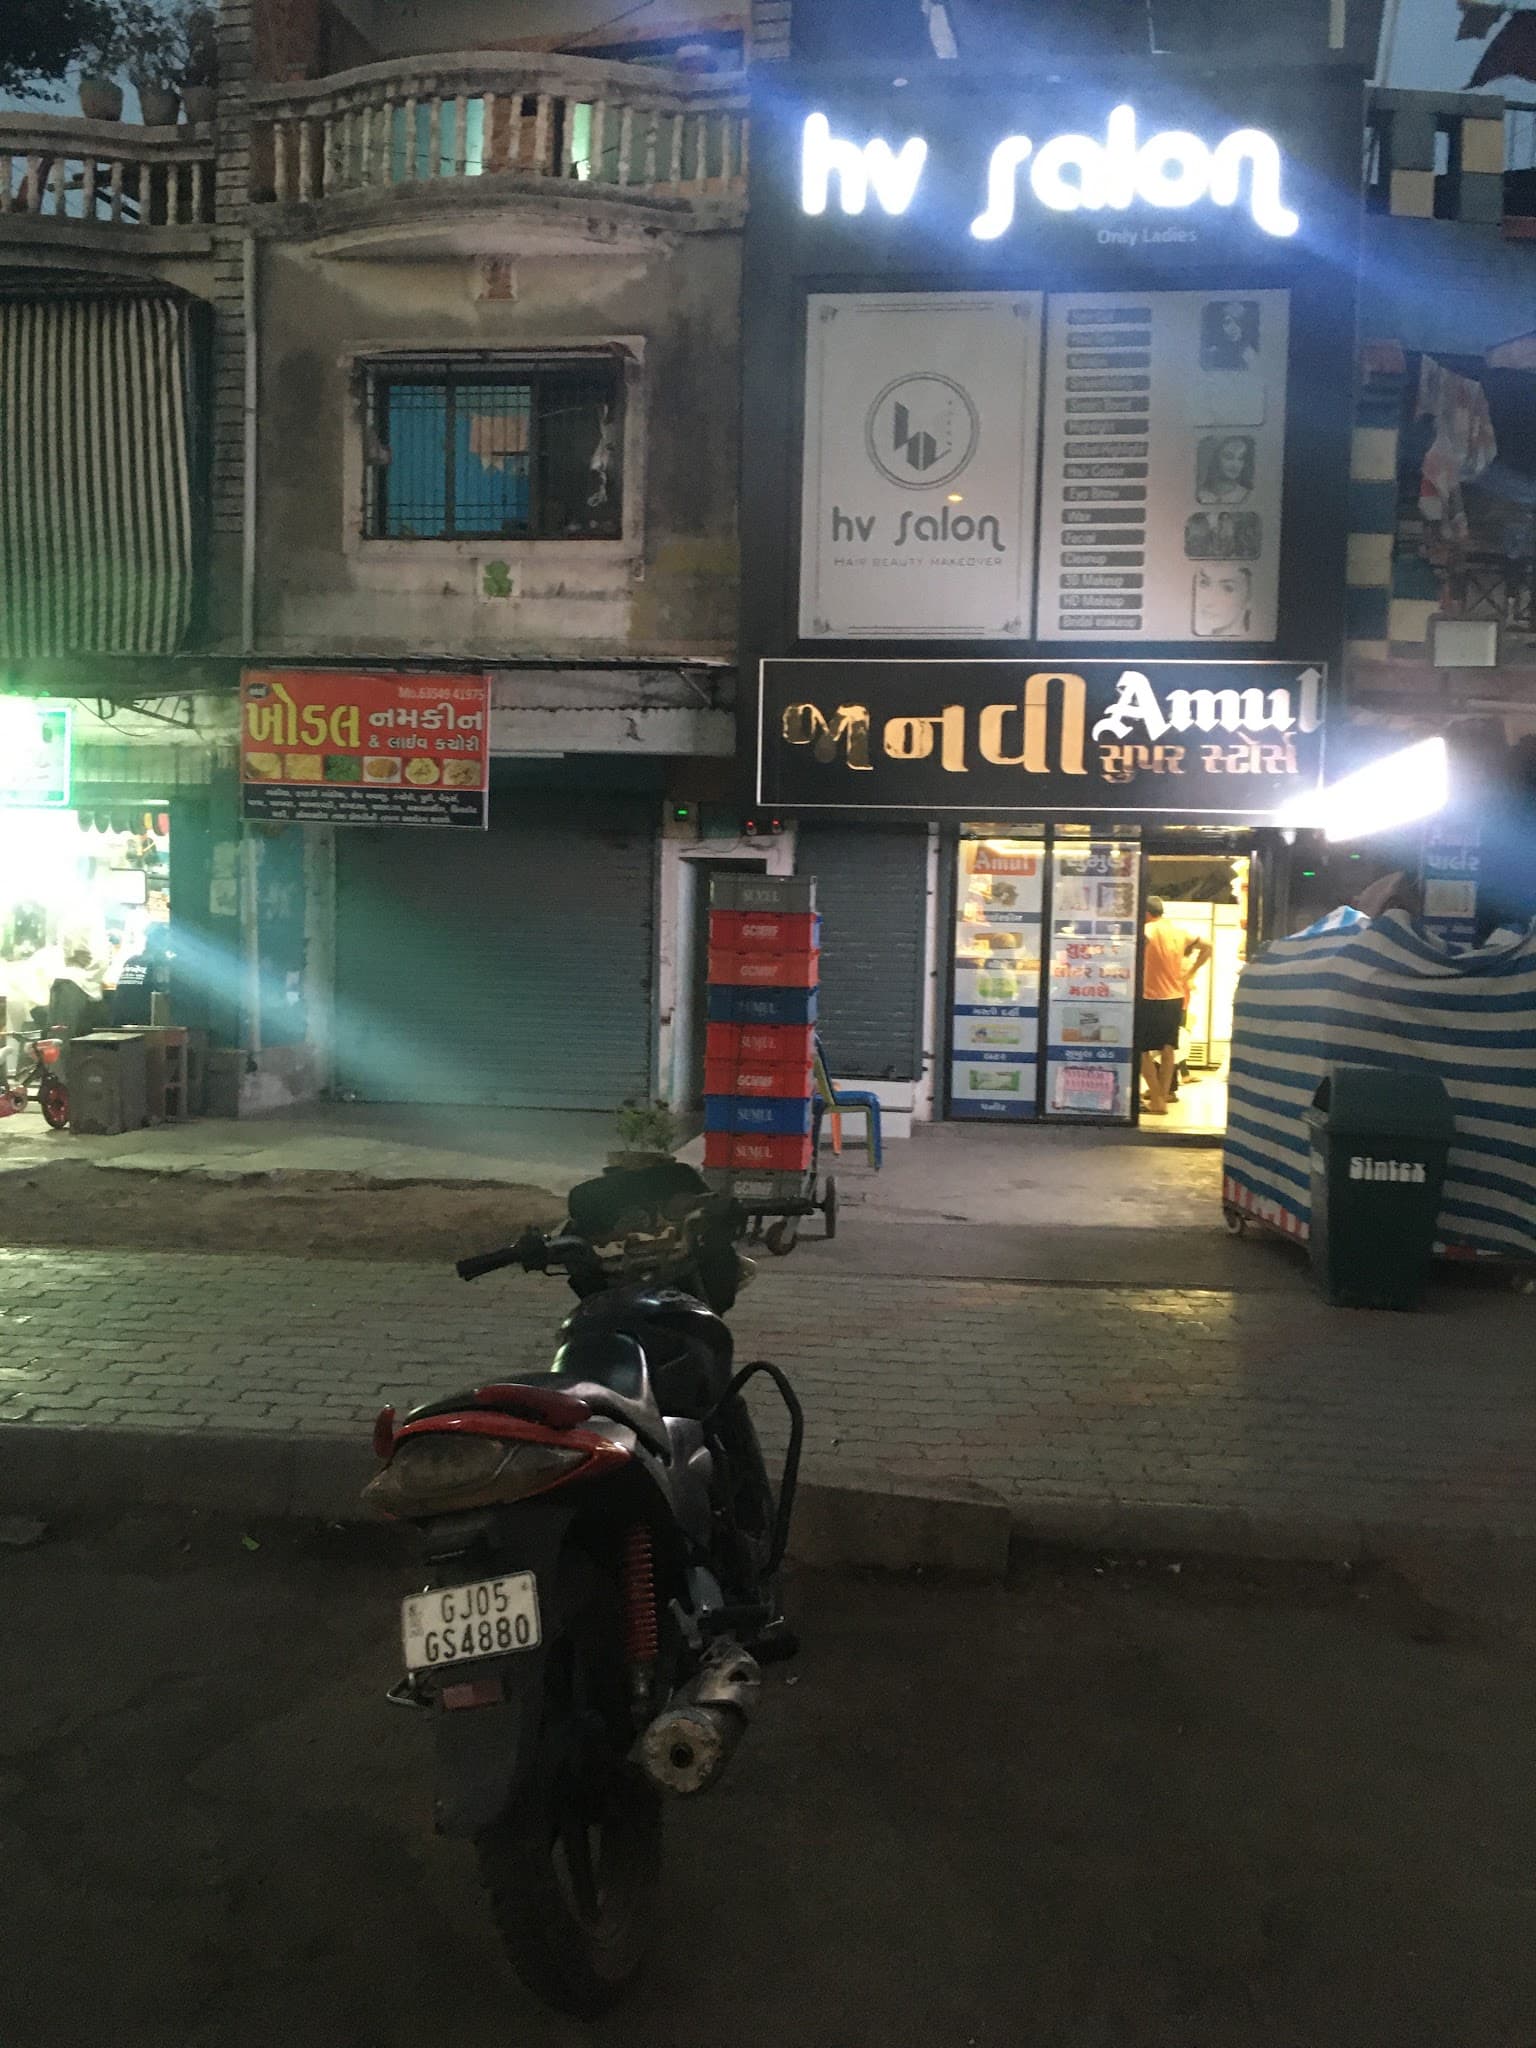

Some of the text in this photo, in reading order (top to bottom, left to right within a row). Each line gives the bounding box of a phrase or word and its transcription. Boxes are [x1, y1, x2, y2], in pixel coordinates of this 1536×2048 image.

[802, 104, 1299, 239] hv salon
[1098, 227, 1197, 246] Only Ladies
[1069, 486, 1089, 500] Eye
[1066, 511, 1091, 522] Wax
[832, 505, 1006, 551] hv salon
[1064, 532, 1096, 544] Facial
[834, 556, 1003, 567] HAIR BEAUTY MAKEOVER
[1082, 573, 1124, 588] Makeup
[1063, 594, 1124, 608] HD Makeup
[246, 683, 361, 748] ખોડલ
[1092, 668, 1323, 742] Amul
[368, 702, 484, 731] નમકીન
[368, 735, 381, 748] &
[1098, 744, 1186, 785] સુપર
[975, 850, 1030, 871] Amul
[441, 1582, 508, 1624] GJ05
[425, 1613, 530, 1662] GS4880
